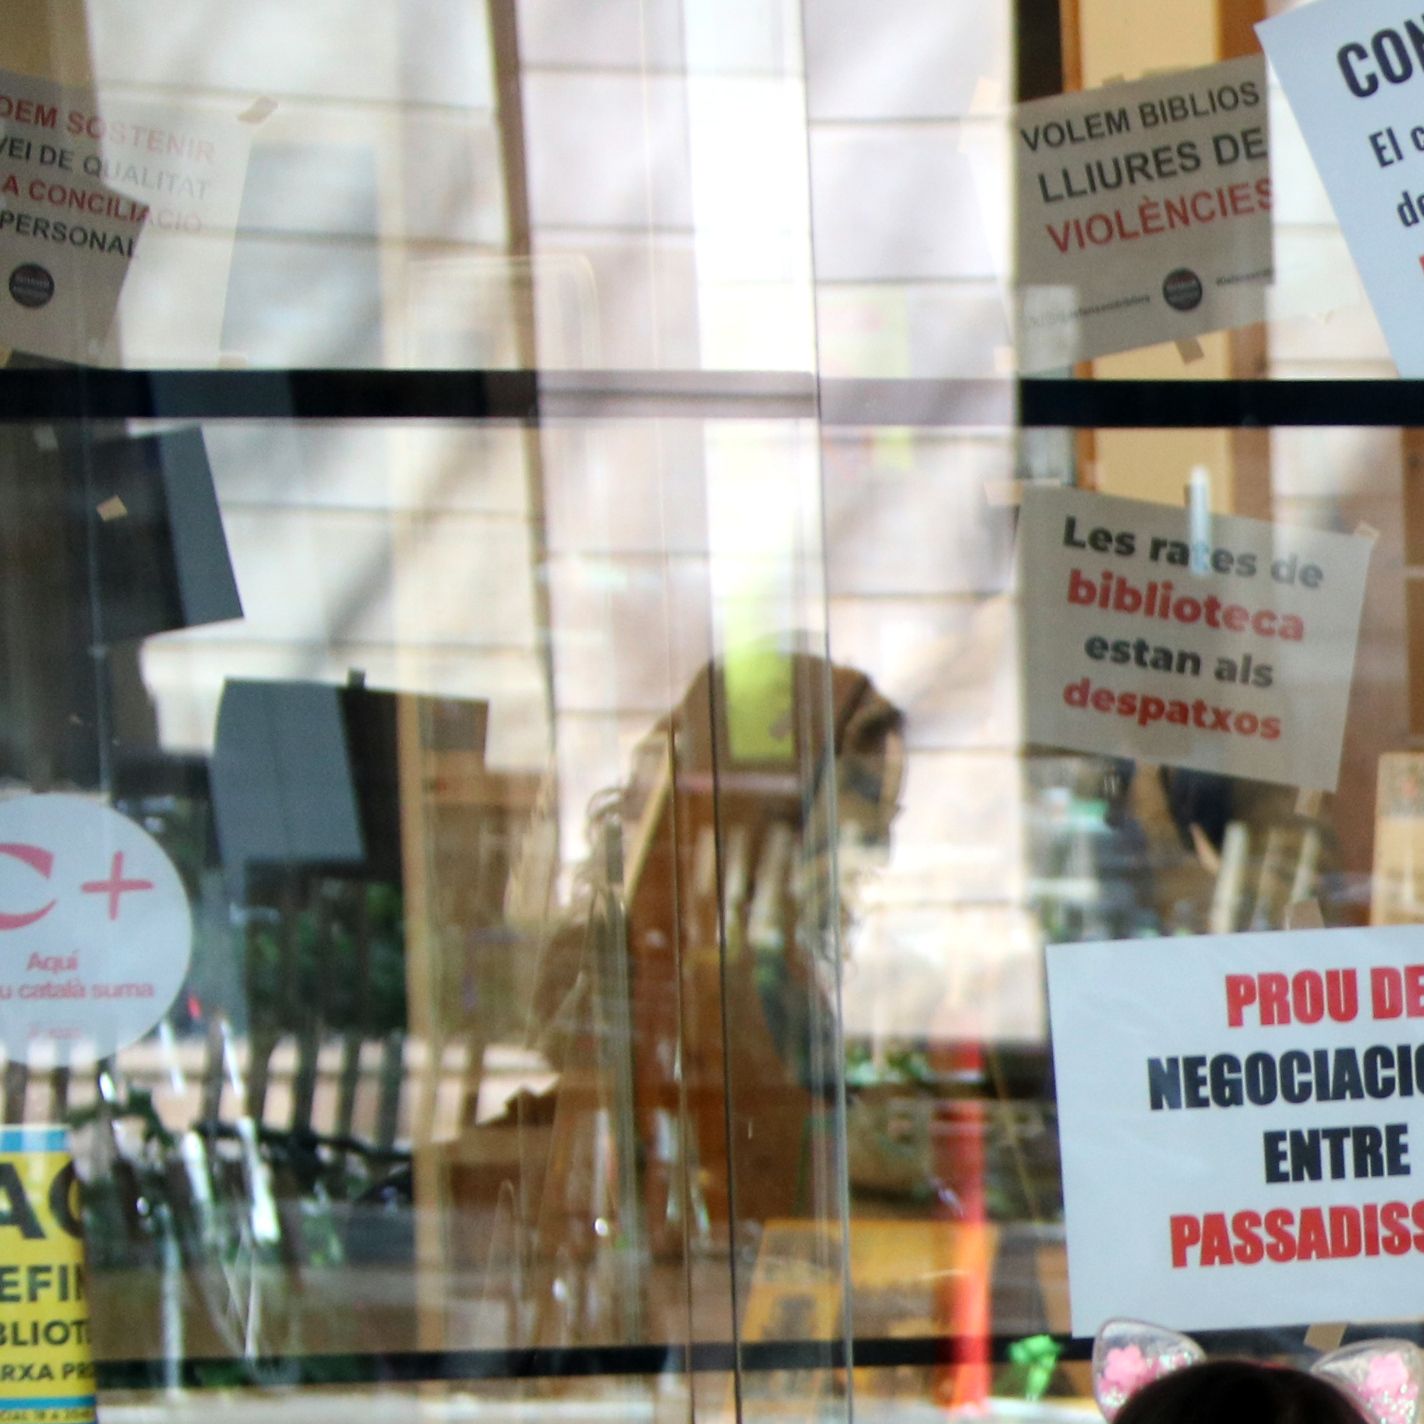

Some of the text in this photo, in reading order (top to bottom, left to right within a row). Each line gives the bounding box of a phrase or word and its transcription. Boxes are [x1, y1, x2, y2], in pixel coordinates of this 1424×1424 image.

[67, 111, 216, 163] SOSTENIR
[1020, 80, 1260, 153] VOLEM BIBLIOS
[40, 145, 73, 170] DE
[83, 156, 208, 199] QUALITAT
[1038, 126, 1269, 203] LLIURES DE
[1369, 127, 1406, 168] El
[1046, 177, 1276, 254] VIOLÈNCIES
[1063, 516, 1324, 590] Les rates de
[1067, 568, 1305, 642] biblioteca
[1084, 632, 1273, 689] estan als
[1063, 678, 1282, 741] despatxos
[18, 977, 86, 999] català
[92, 982, 156, 998] suma
[26, 950, 79, 973] Aquí
[1225, 967, 1359, 1028] PROU
[1263, 1122, 1411, 1184] ENTRE
